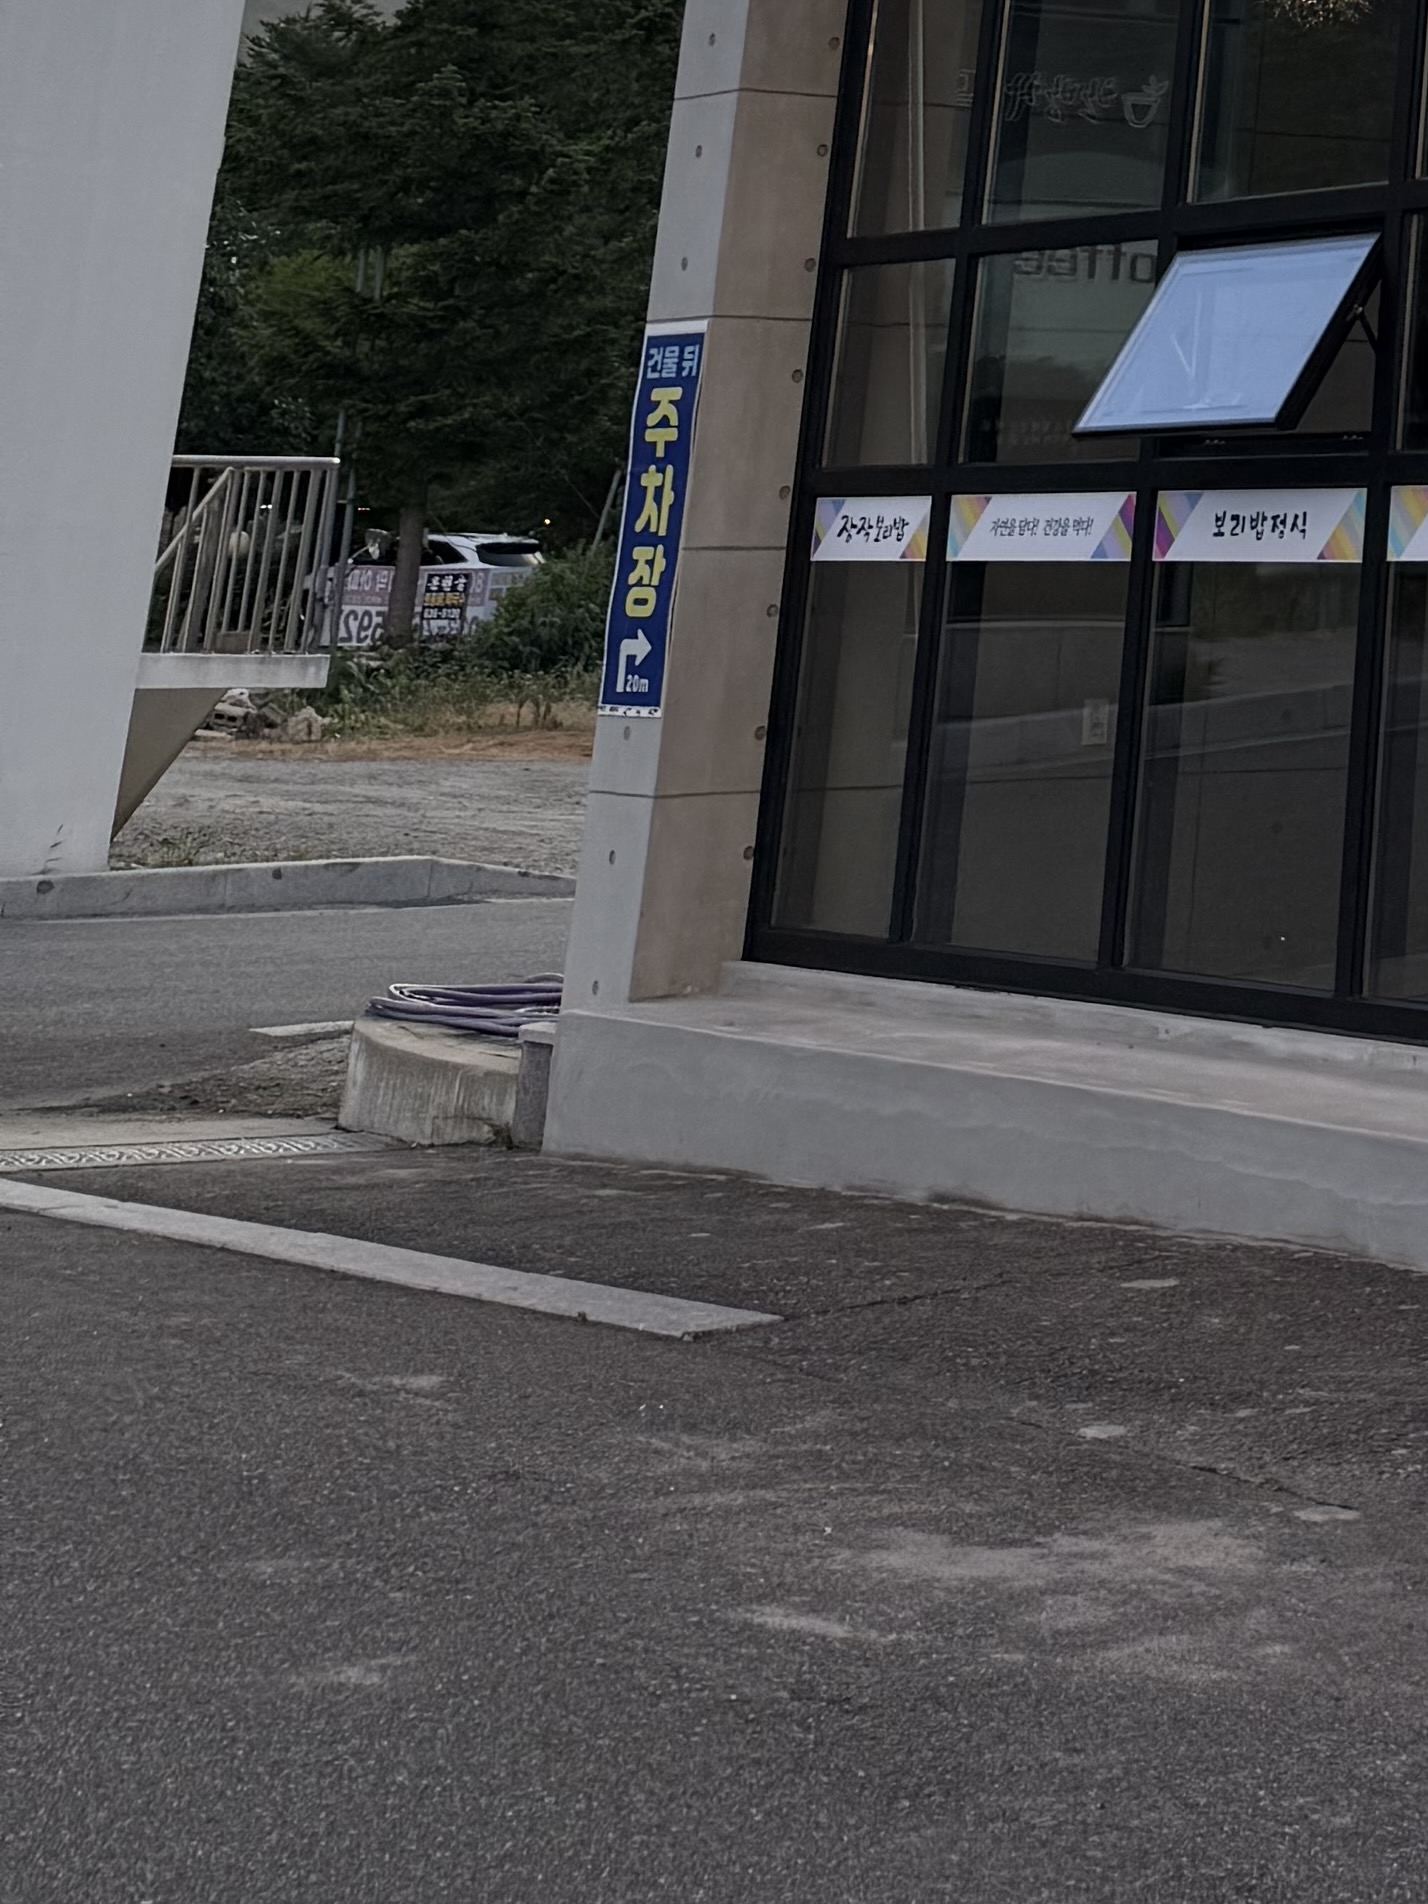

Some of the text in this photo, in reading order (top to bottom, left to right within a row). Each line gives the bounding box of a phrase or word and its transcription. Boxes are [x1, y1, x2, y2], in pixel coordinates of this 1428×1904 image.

[646, 343, 699, 380] 건물 뒤
[624, 386, 683, 618] 주차장
[836, 514, 910, 544] 장작보리밥
[1212, 510, 1308, 542] 보리밥정식
[625, 673, 650, 694] 20m
